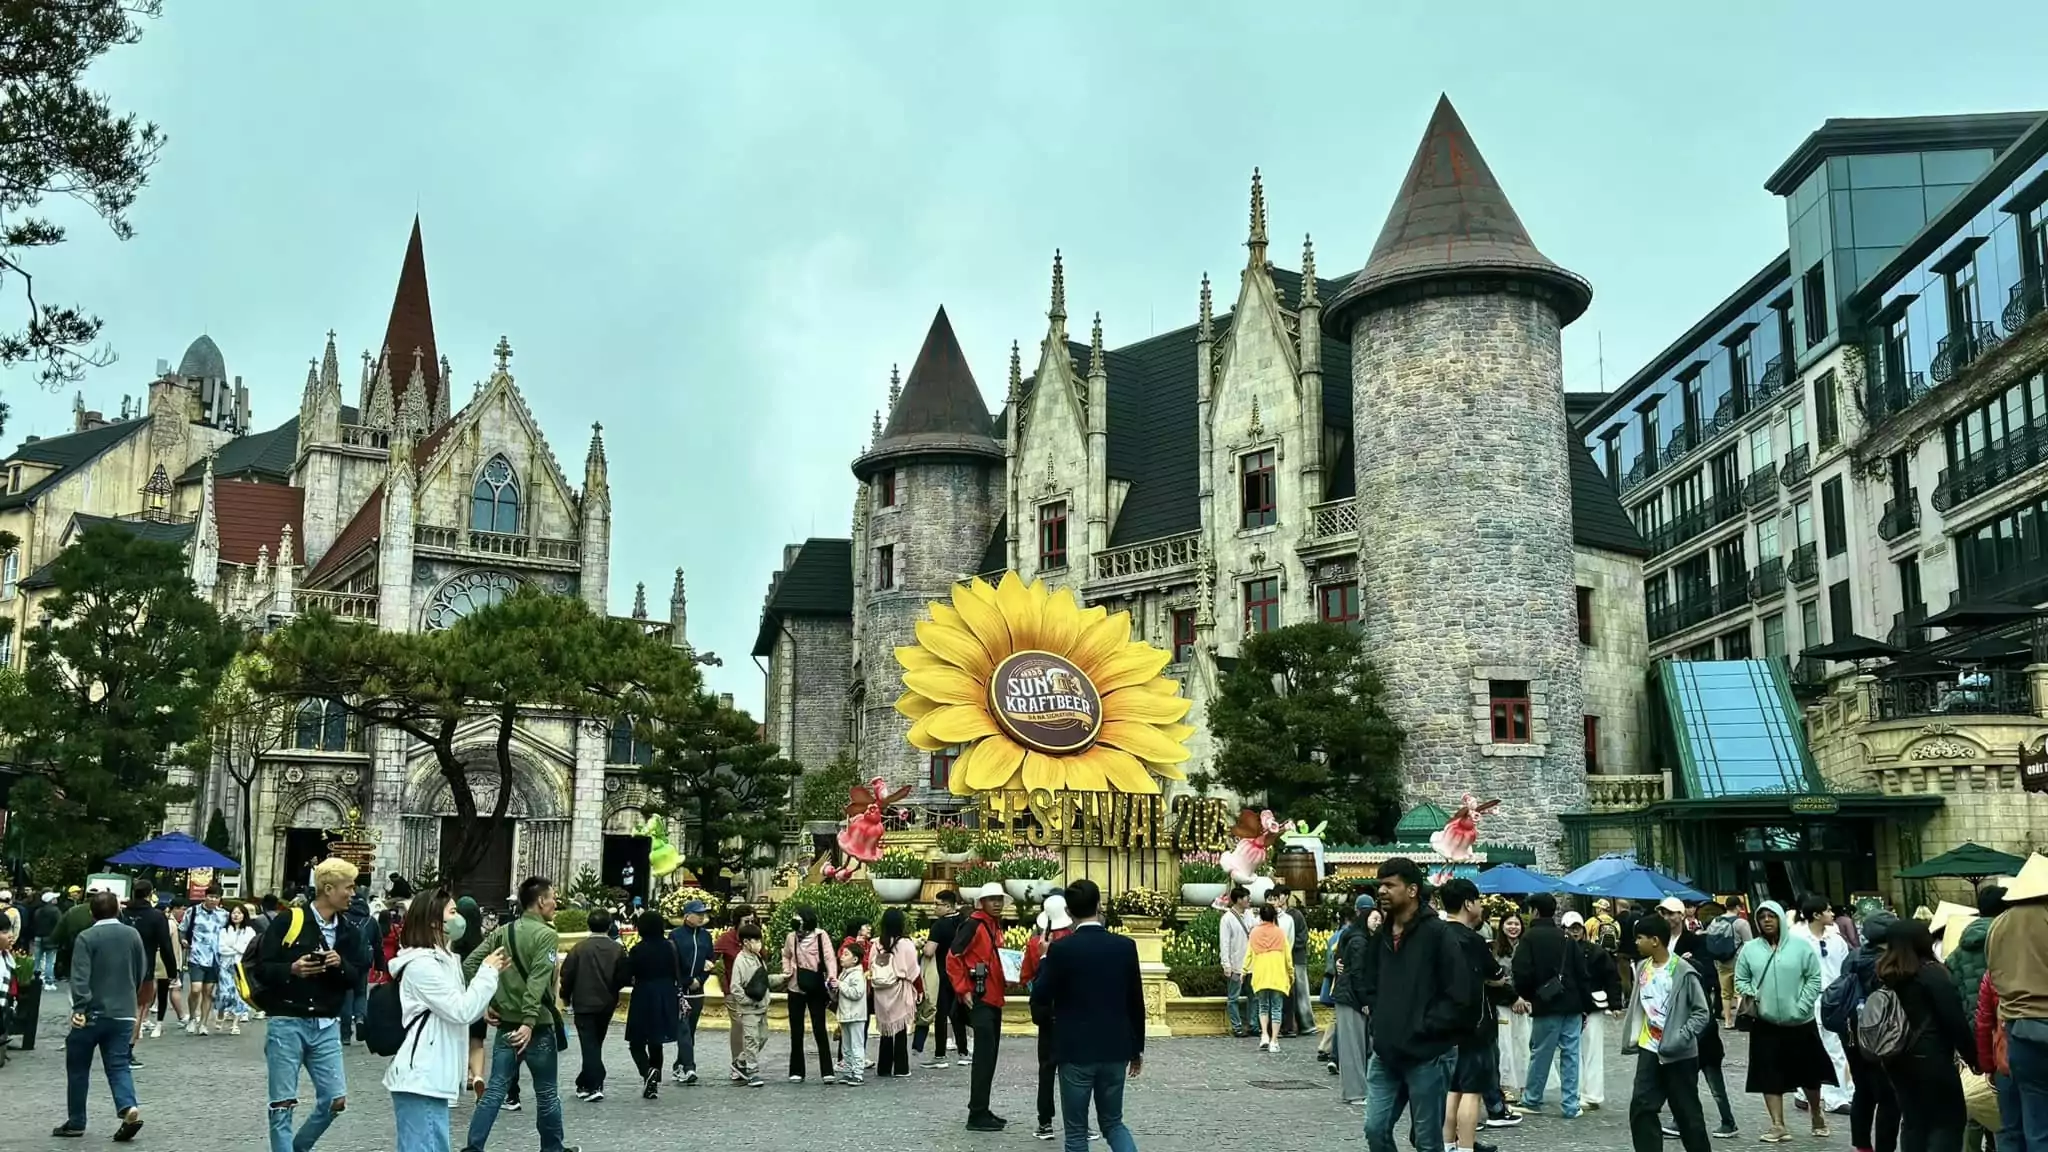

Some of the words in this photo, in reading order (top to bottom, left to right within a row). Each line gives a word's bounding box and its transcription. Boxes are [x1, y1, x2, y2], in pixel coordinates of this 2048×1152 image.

[1008, 676, 1049, 696] SUN
[1005, 695, 1092, 714] KRAFTBEER
[978, 790, 1173, 848] FESTIVAL
